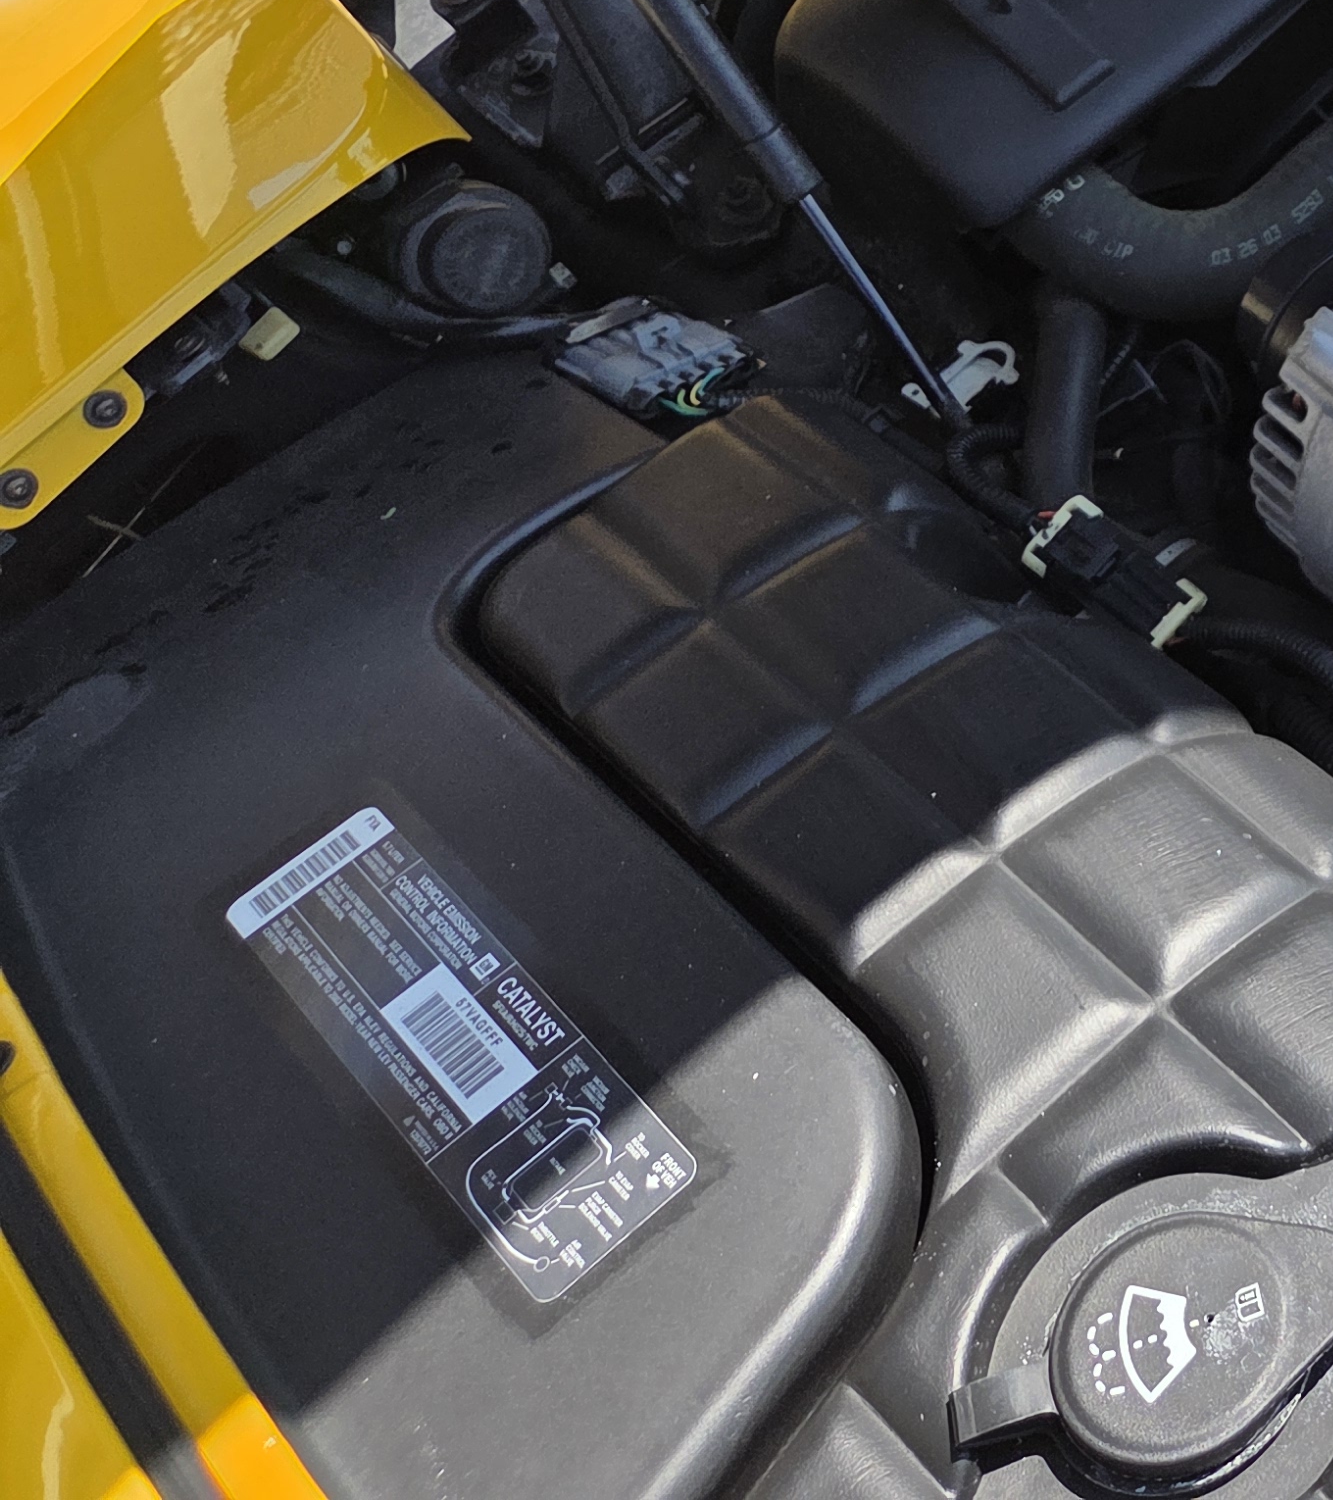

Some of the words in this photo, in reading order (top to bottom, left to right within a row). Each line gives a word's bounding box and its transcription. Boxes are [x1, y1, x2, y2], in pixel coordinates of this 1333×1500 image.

[338, 881, 374, 919] ADJUSTMENTS
[398, 950, 422, 976] SERVICE
[388, 888, 414, 914] GENERAL
[407, 909, 431, 934] MOTORS
[425, 930, 464, 970] CORPORATION
[393, 874, 432, 914] CONTROL
[424, 909, 478, 965] INFORMATION
[414, 873, 451, 909] VEHICLE
[442, 903, 482, 945] EMISSION
[384, 951, 399, 967] FOR
[394, 963, 413, 983] MORE
[478, 958, 494, 973] GM
[269, 920, 302, 955] REGULATIONS
[376, 1050, 393, 1066] LEV
[386, 1061, 421, 1101] PASSENGER
[431, 1116, 450, 1136] OBD
[289, 925, 314, 951] VEHICLE
[334, 979, 346, 991] TO
[351, 1001, 367, 1017] EPA
[376, 1031, 417, 1077] REGULATIONS
[413, 1074, 430, 1092] AND
[425, 1090, 463, 1133] CALIFORNIA
[494, 974, 566, 1049] CATALYST
[590, 1190, 605, 1205] EVAP
[619, 1176, 634, 1192] EVAP
[649, 1159, 666, 1175] OF
[658, 1168, 678, 1189] VEH
[658, 1151, 687, 1181] FRONT
